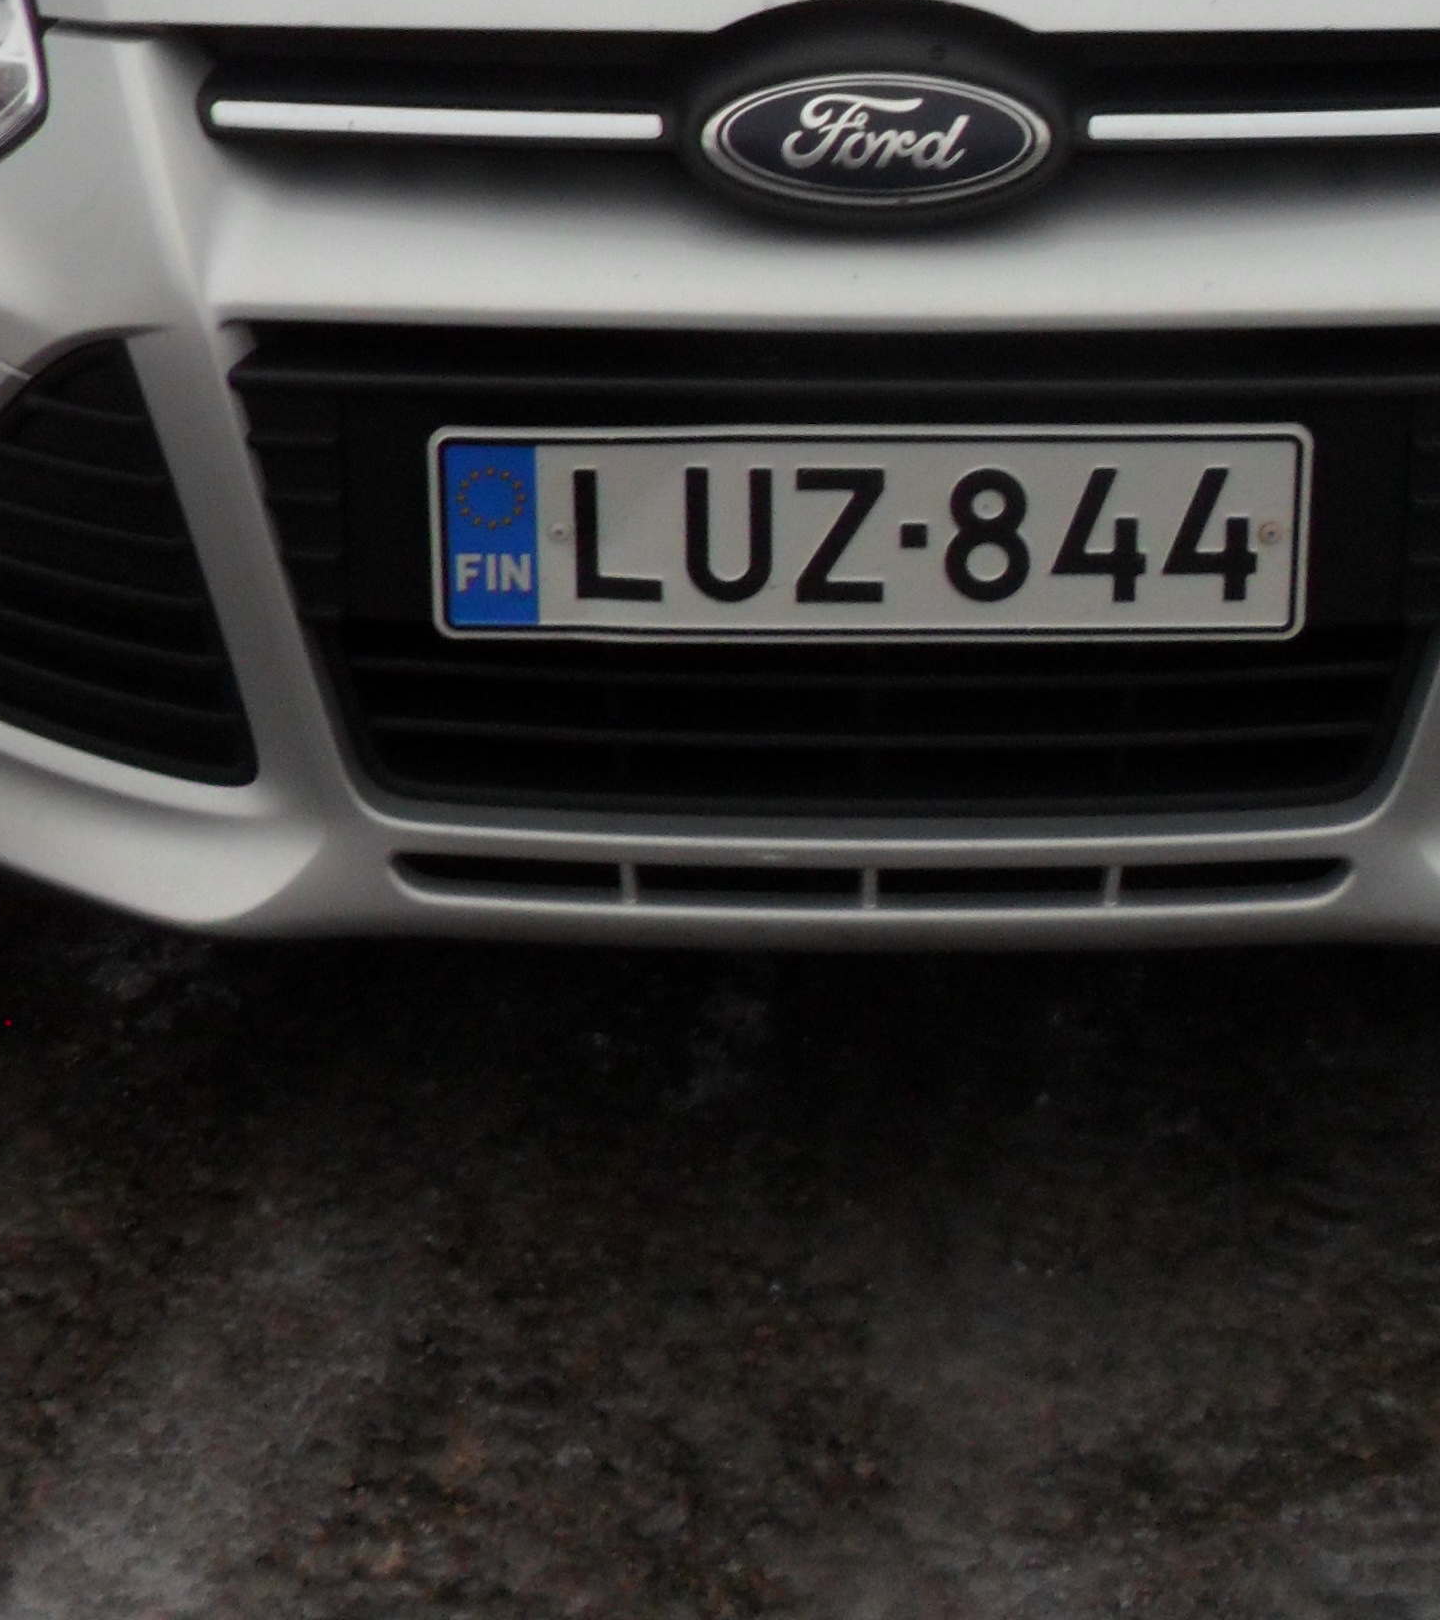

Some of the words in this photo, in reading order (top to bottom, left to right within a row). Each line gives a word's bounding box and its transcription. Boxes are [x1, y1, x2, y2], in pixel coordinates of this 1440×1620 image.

[782, 93, 970, 170] Ford
[456, 552, 532, 593] FIN
[572, 467, 1258, 603] LUZ-844
